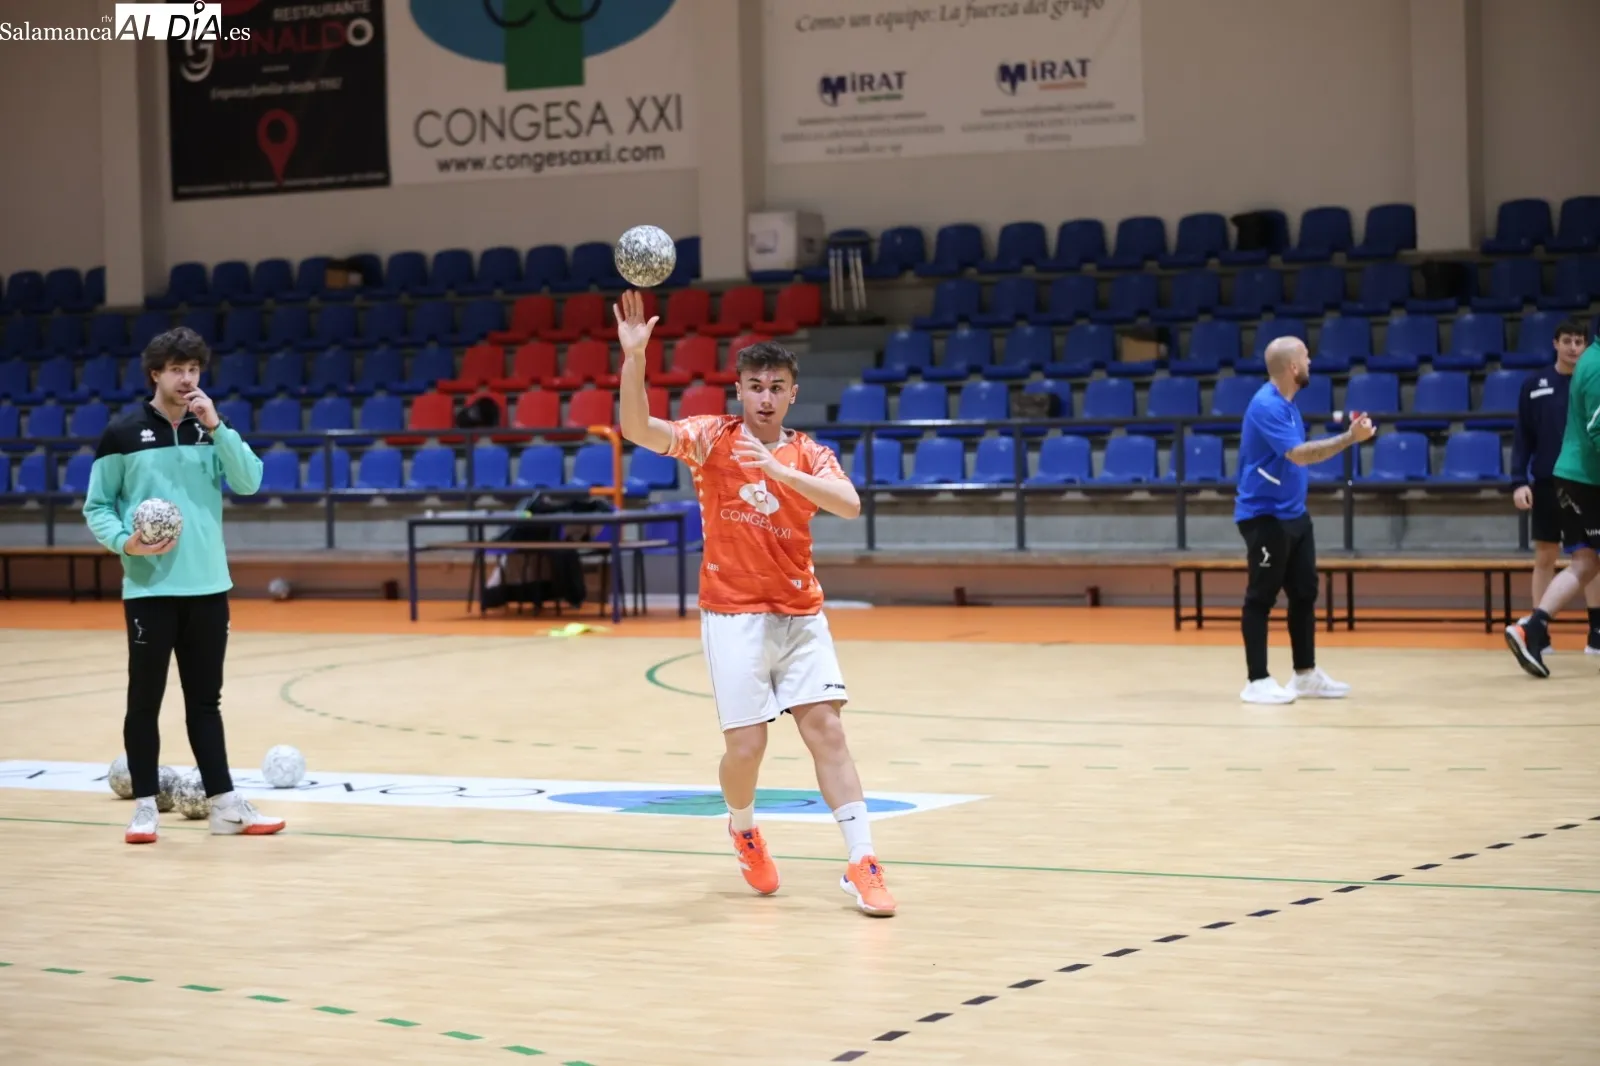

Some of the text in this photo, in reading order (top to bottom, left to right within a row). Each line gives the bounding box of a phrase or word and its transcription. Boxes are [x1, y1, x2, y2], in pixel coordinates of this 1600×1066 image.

[272, 2, 372, 22] RESTAURANTE
[795, 13, 845, 32] Como
[849, 15, 872, 28] un
[938, 3, 960, 22] La
[960, 1, 1019, 27] fuerza
[412, 93, 684, 149] CONGESA XXI
[435, 142, 667, 173] www.congesaxxi.com
